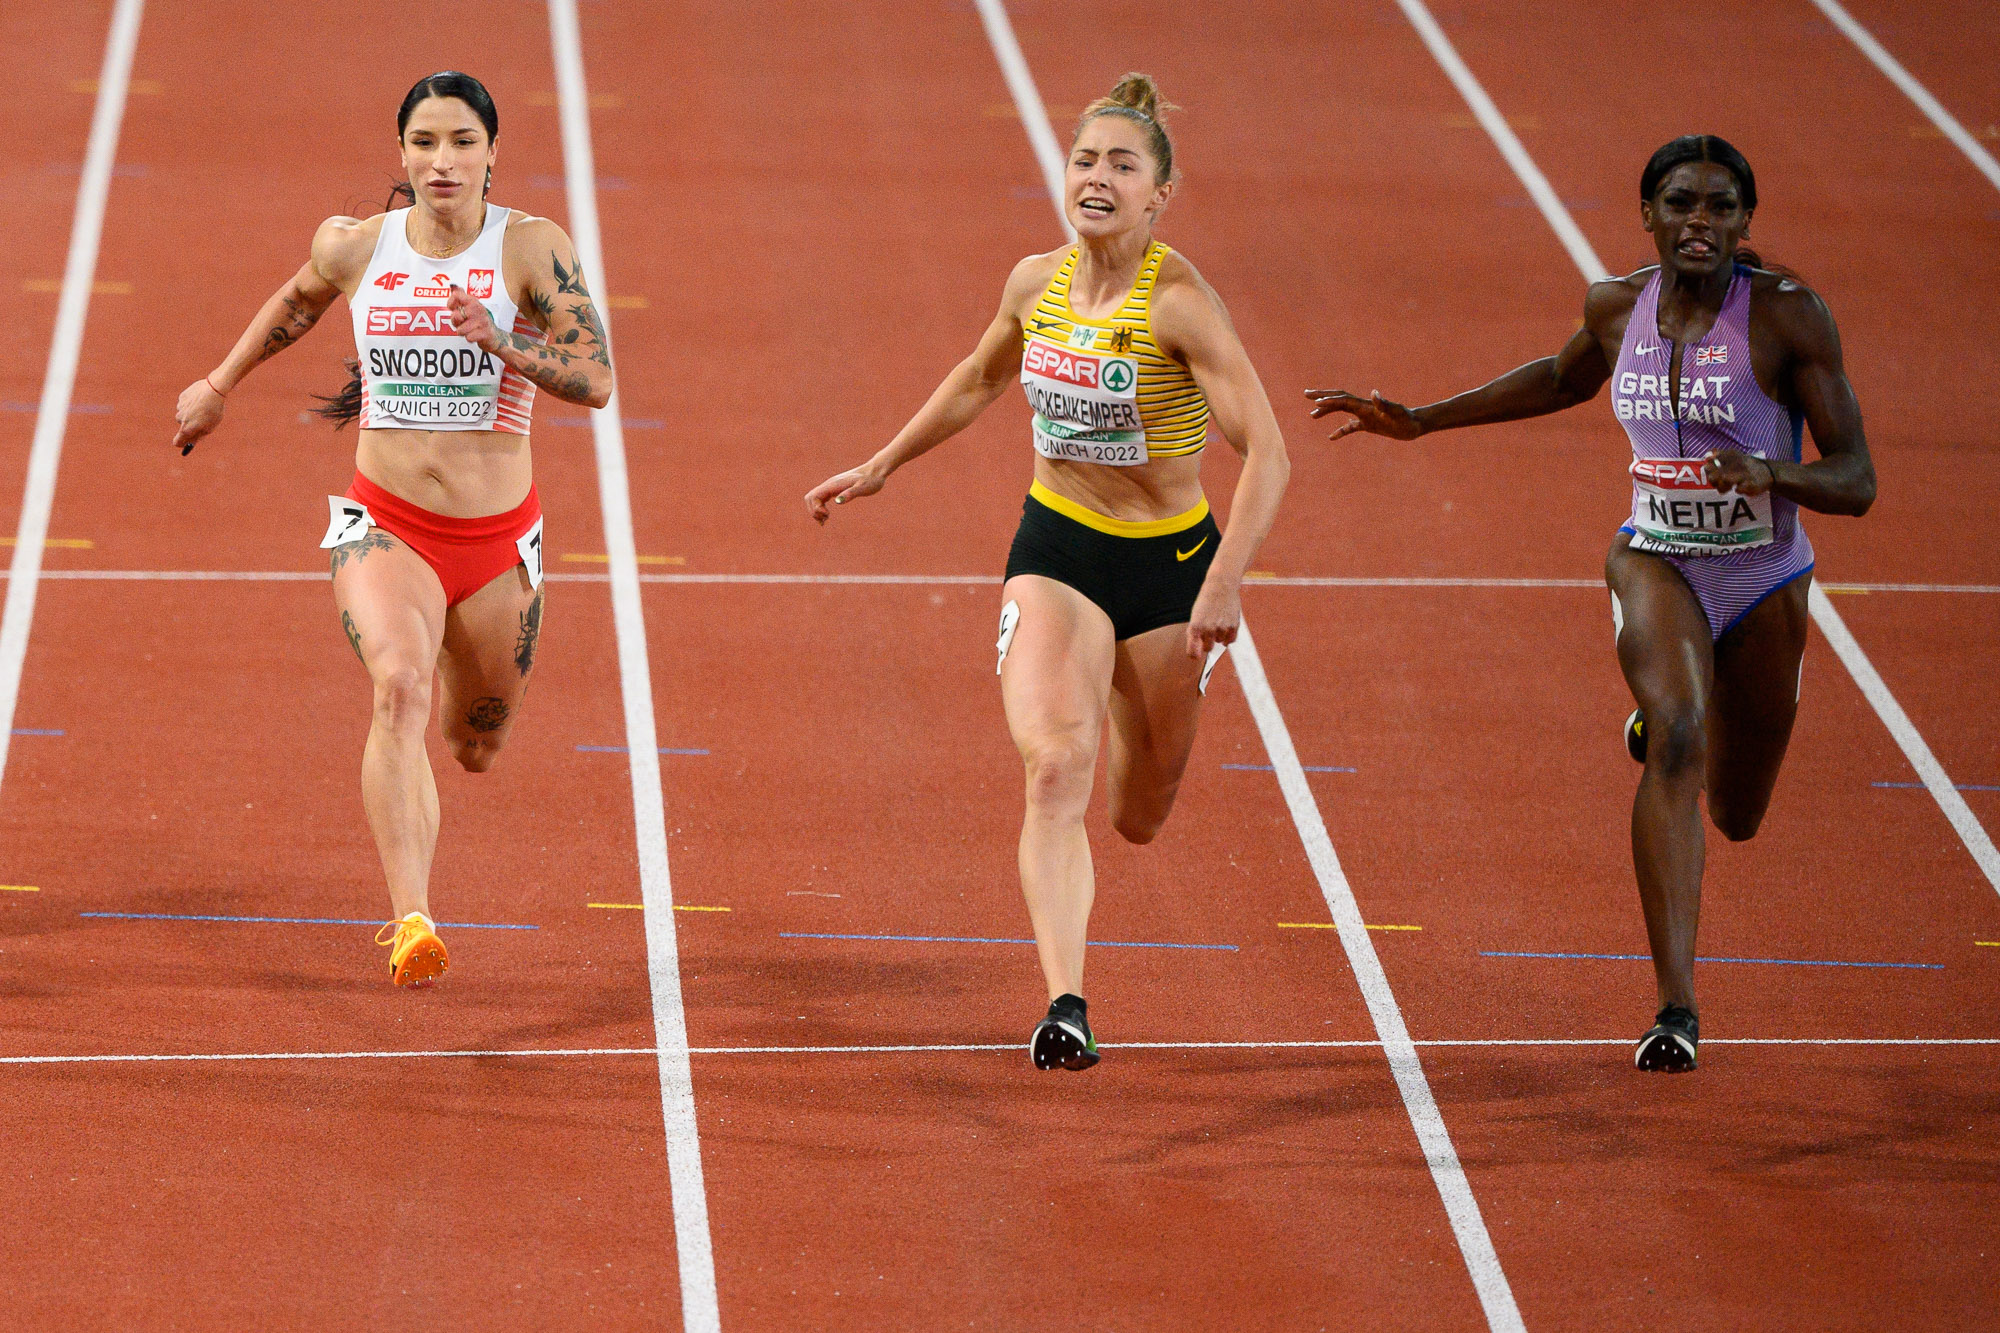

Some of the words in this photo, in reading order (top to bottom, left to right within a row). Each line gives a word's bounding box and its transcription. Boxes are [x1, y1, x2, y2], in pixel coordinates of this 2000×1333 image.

[374, 271, 410, 291] 4F
[415, 288, 449, 297] ORLEN
[369, 348, 495, 378] SWOBODA
[1026, 346, 1097, 385] SPAR
[396, 385, 400, 395] I
[402, 385, 426, 395] RUN
[1619, 372, 1731, 399] GREAT
[447, 400, 492, 417] 2022
[1618, 398, 1736, 425] BRITAIN
[1050, 424, 1071, 438] RUN
[1094, 446, 1139, 461] 2022
[1649, 494, 1757, 529] NEITA
[336, 507, 364, 541] 7
